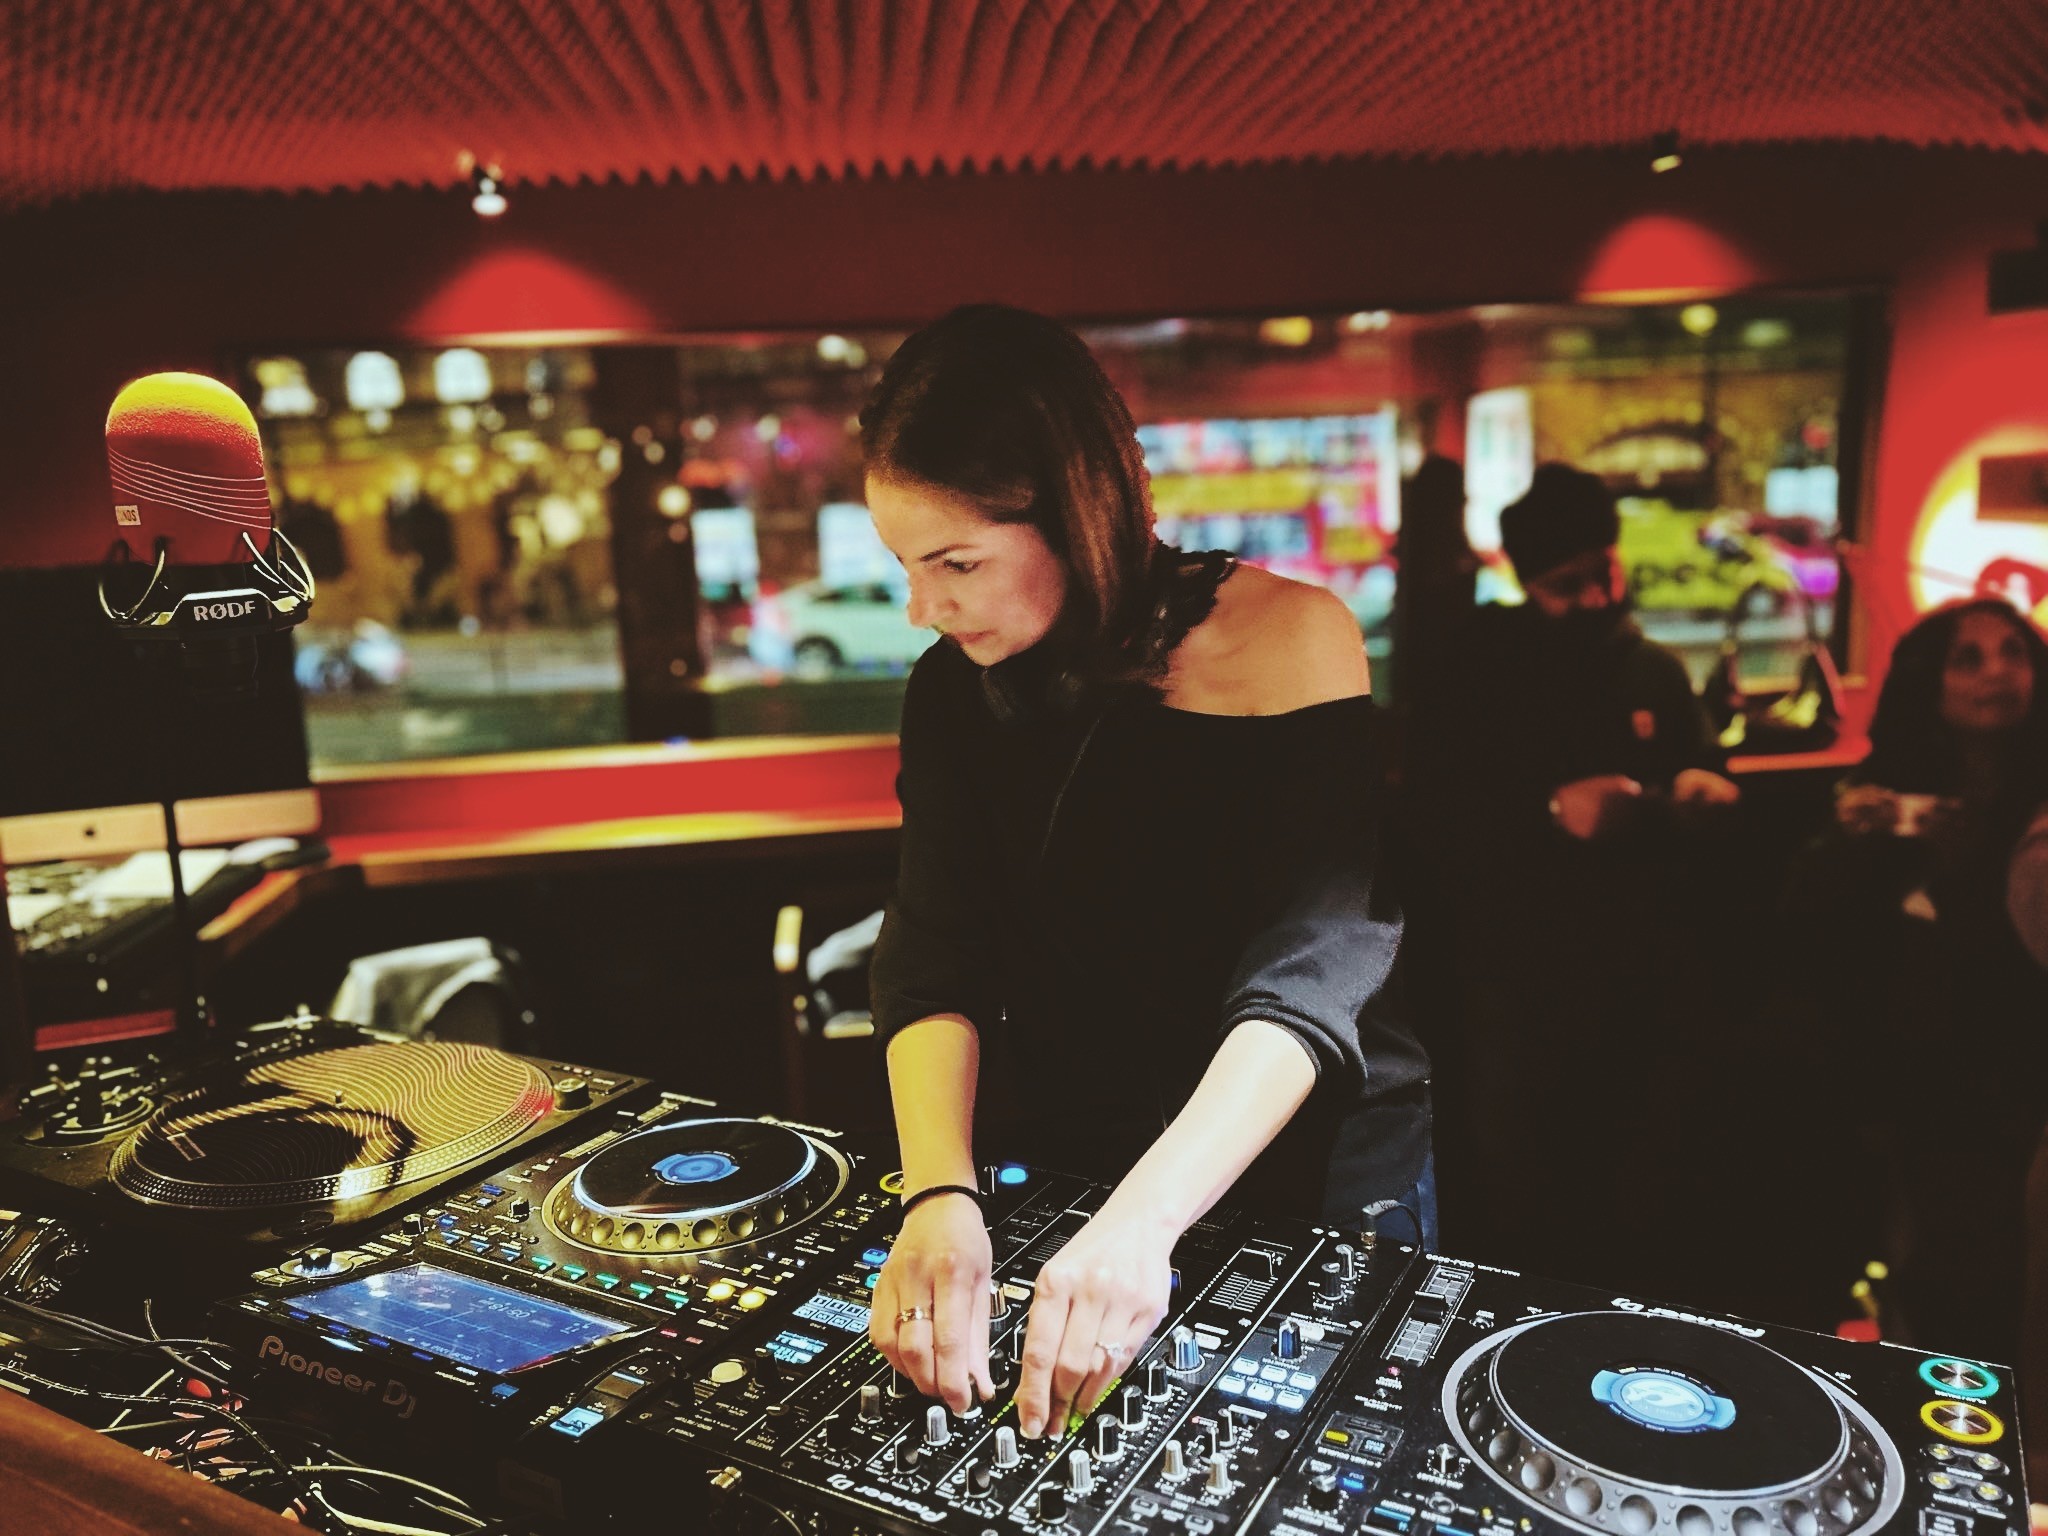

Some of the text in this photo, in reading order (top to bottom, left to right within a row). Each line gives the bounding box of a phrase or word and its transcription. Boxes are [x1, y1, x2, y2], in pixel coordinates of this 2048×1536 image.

[1647, 1308, 1766, 1338] Pioneer
[258, 1335, 377, 1395] Pioneer
[853, 1485, 948, 1523] Pioneer
